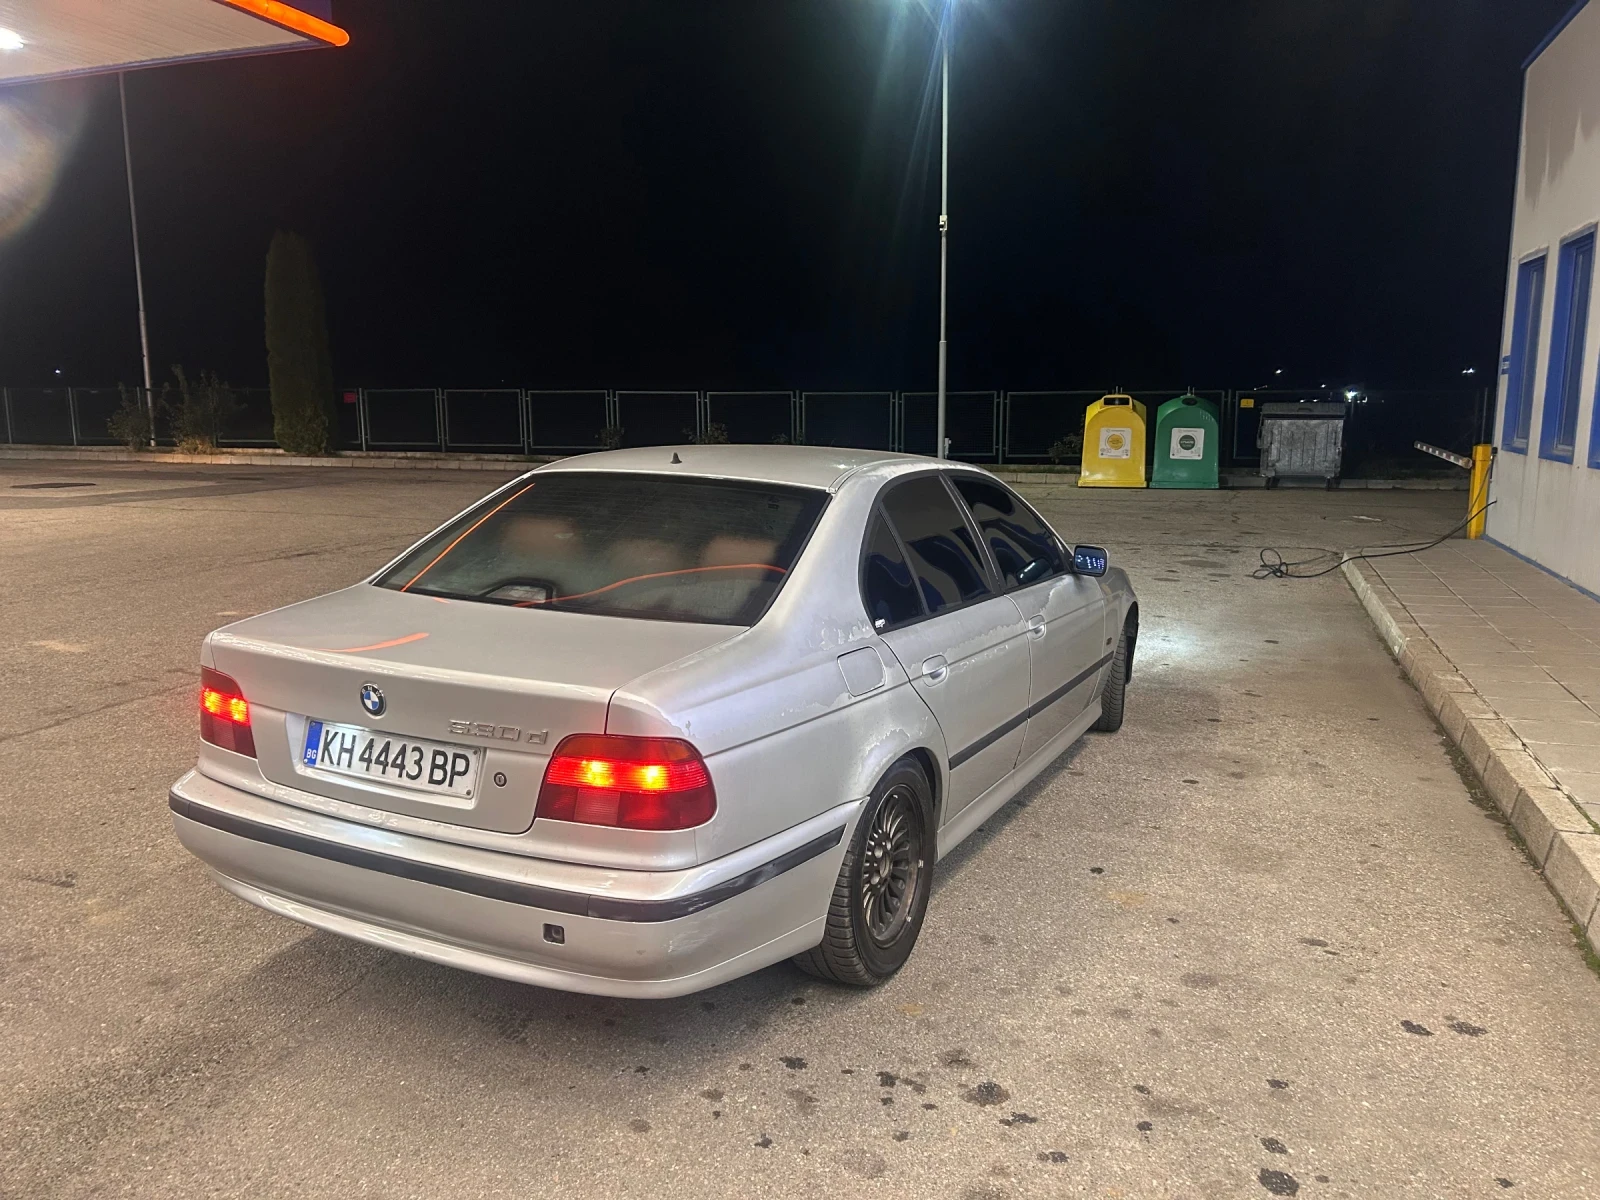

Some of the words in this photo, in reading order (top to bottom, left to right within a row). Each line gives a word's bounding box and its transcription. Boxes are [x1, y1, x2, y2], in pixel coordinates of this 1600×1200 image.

[306, 748, 317, 760] BG
[320, 729, 357, 768] KH
[358, 737, 424, 781] 4443
[427, 748, 470, 788] BP
